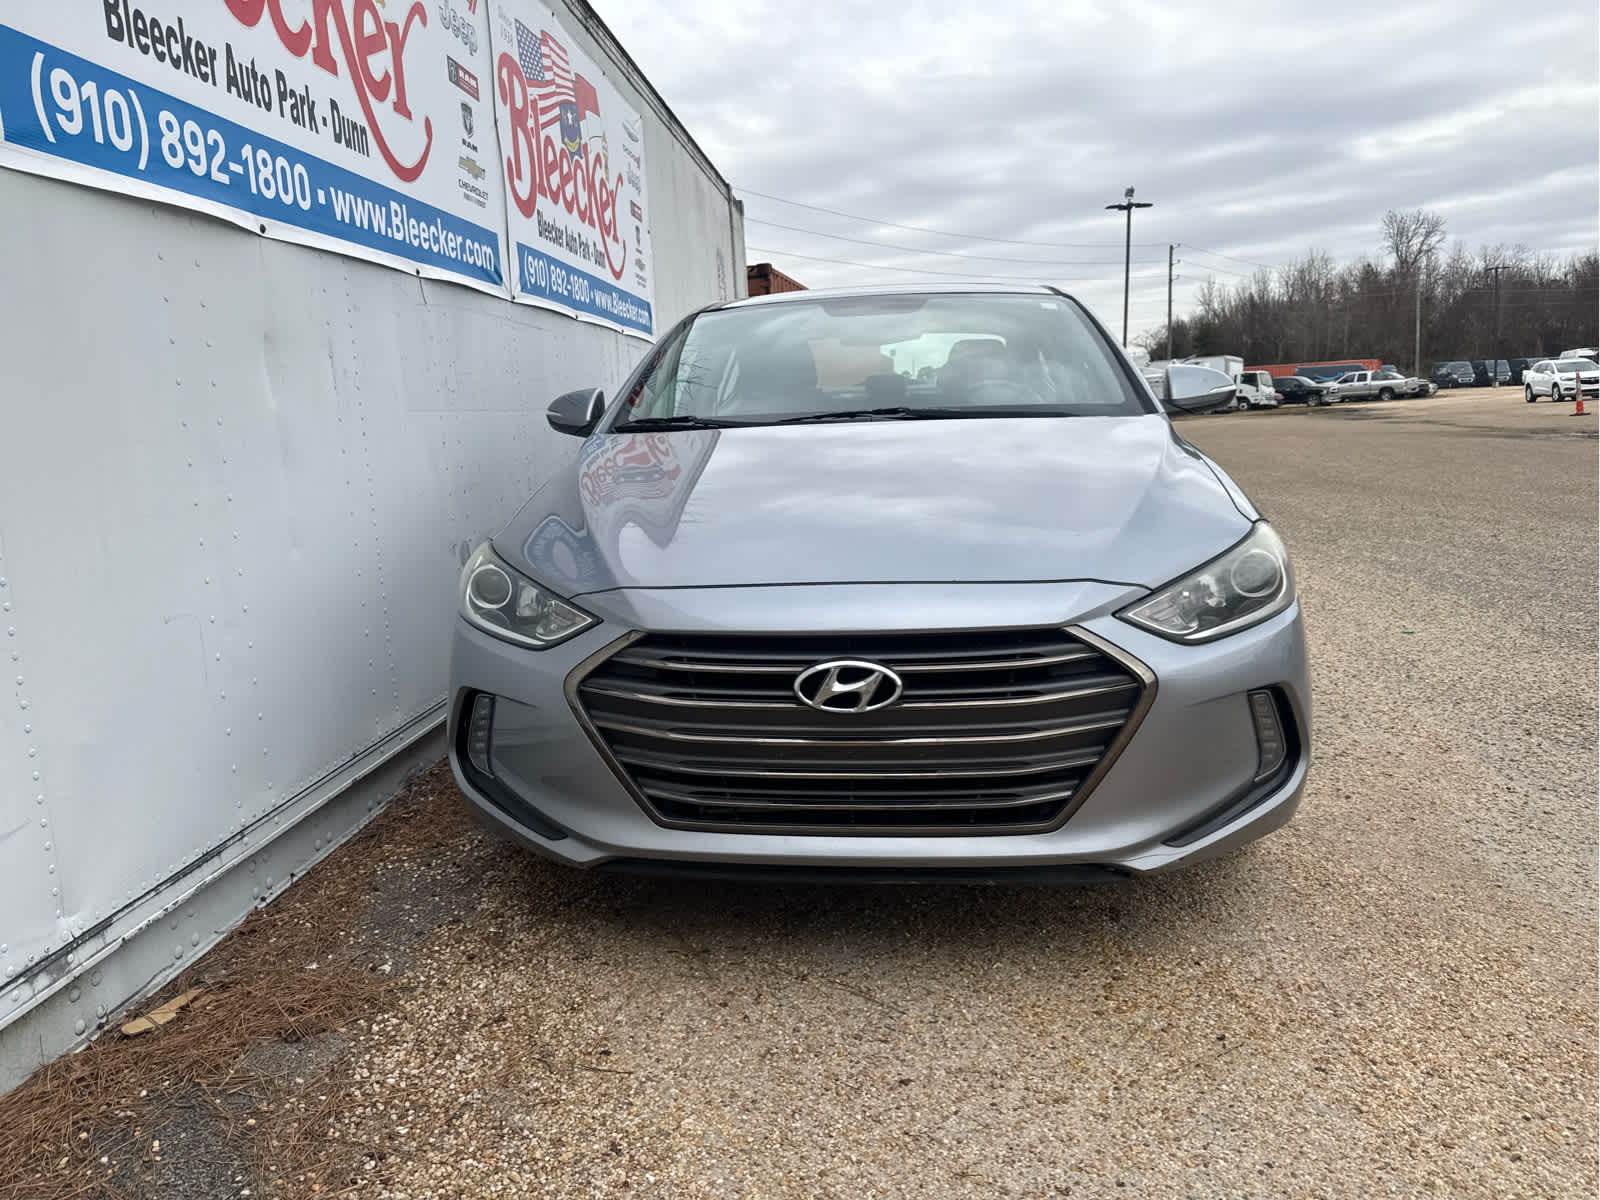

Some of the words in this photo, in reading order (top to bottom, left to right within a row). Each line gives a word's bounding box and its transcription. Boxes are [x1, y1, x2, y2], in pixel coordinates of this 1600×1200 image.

[103, 0, 217, 87] Bleecker
[225, 42, 272, 113] Auto
[275, 68, 320, 135] Park
[329, 98, 370, 158] Dunn
[462, 138, 478, 153] RAM
[31, 51, 149, 170] (910)
[158, 110, 311, 210] 892-1800
[329, 186, 496, 272] www.Bleecker.com
[497, 52, 626, 281] Bleecker
[524, 249, 550, 296] (910)
[550, 264, 590, 304] 892-1800
